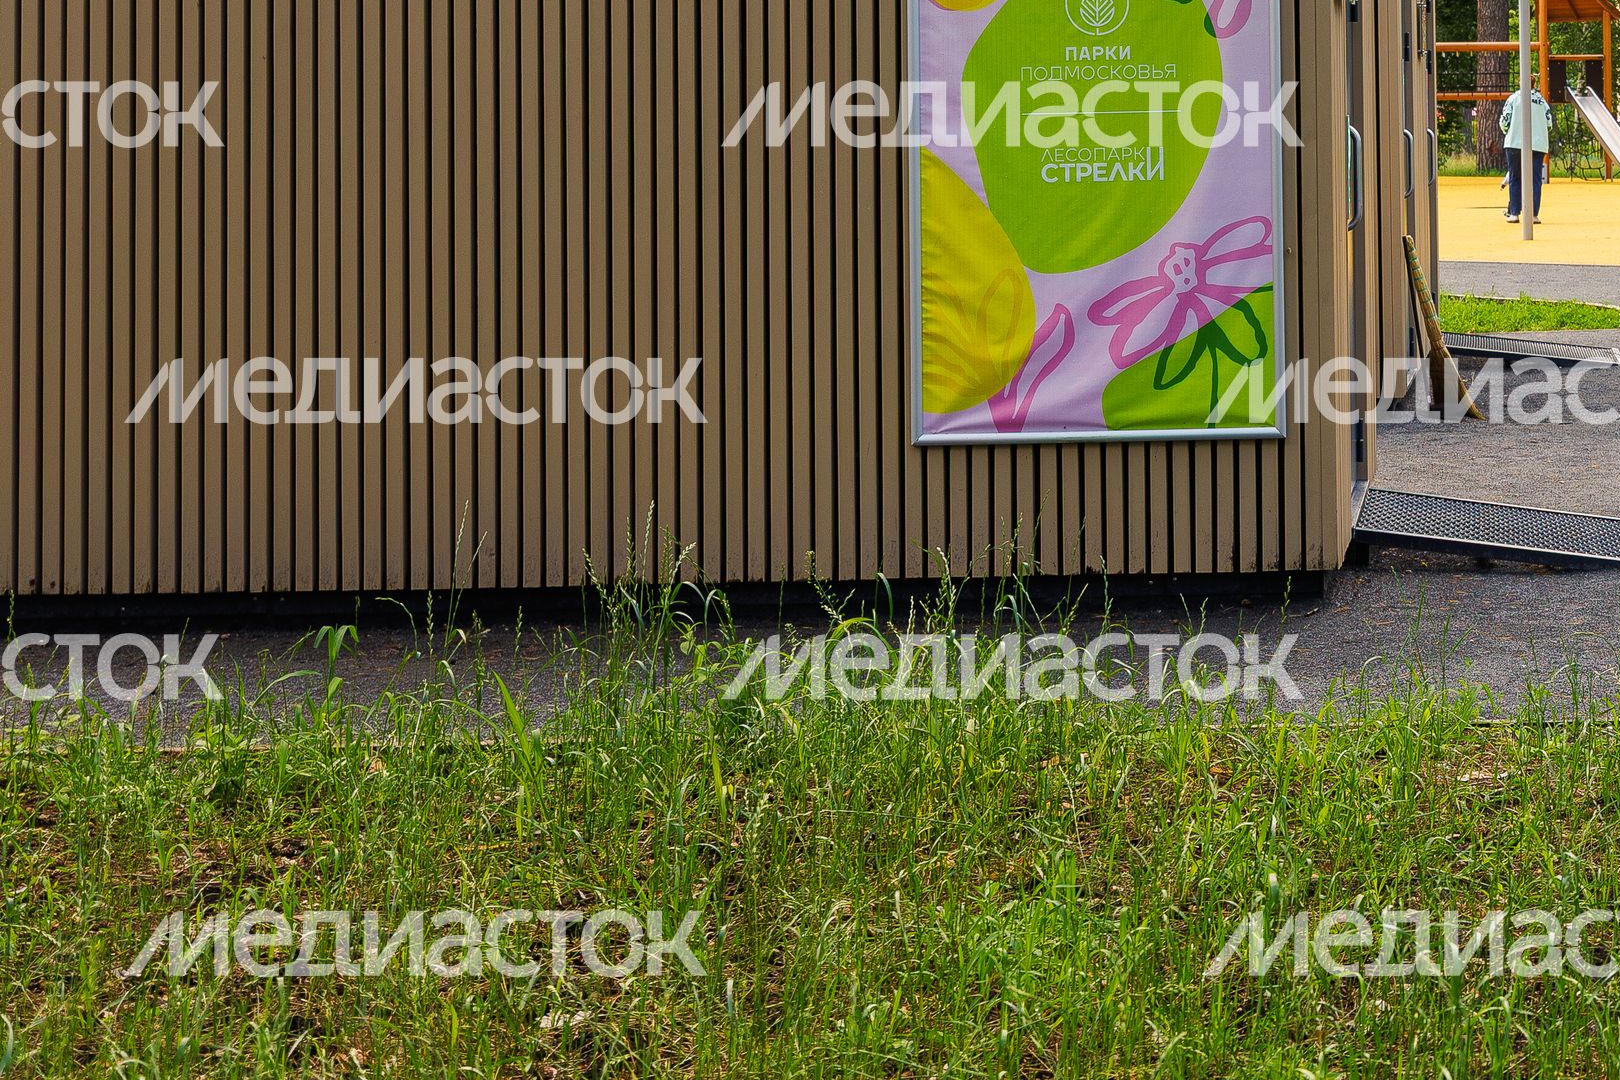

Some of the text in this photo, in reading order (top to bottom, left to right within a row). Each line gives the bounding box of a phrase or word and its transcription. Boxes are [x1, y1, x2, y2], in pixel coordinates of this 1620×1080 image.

[1065, 46, 1131, 61] ПАРКИ
[1020, 64, 1176, 81] ПОДМОСКОВЬЯ
[1041, 147, 1164, 183] СТРЕЛКИ
